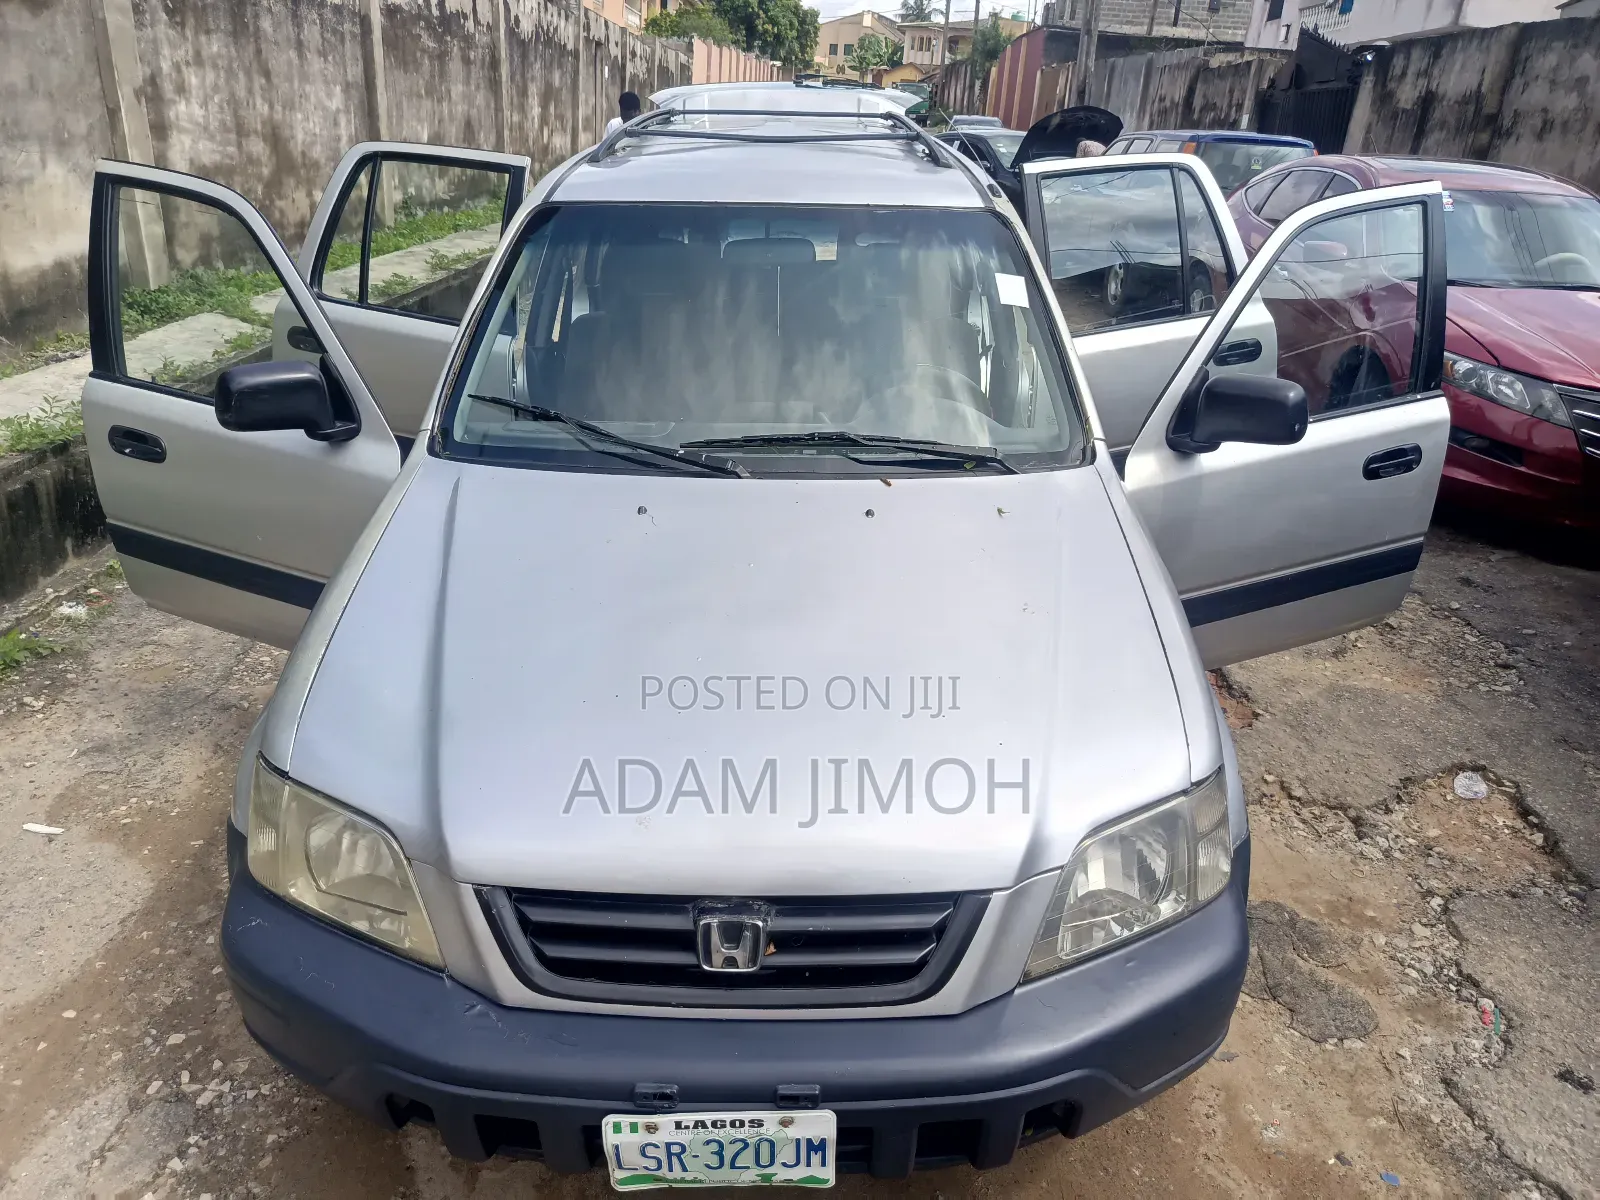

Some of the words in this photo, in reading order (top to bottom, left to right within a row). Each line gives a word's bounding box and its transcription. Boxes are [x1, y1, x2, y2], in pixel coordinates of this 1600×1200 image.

[674, 1118, 765, 1130] LAGOS
[668, 1129, 701, 1137] CENTRE
[718, 1127, 771, 1136] EXCELLENCE
[612, 1137, 828, 1173] LSR-320JM
